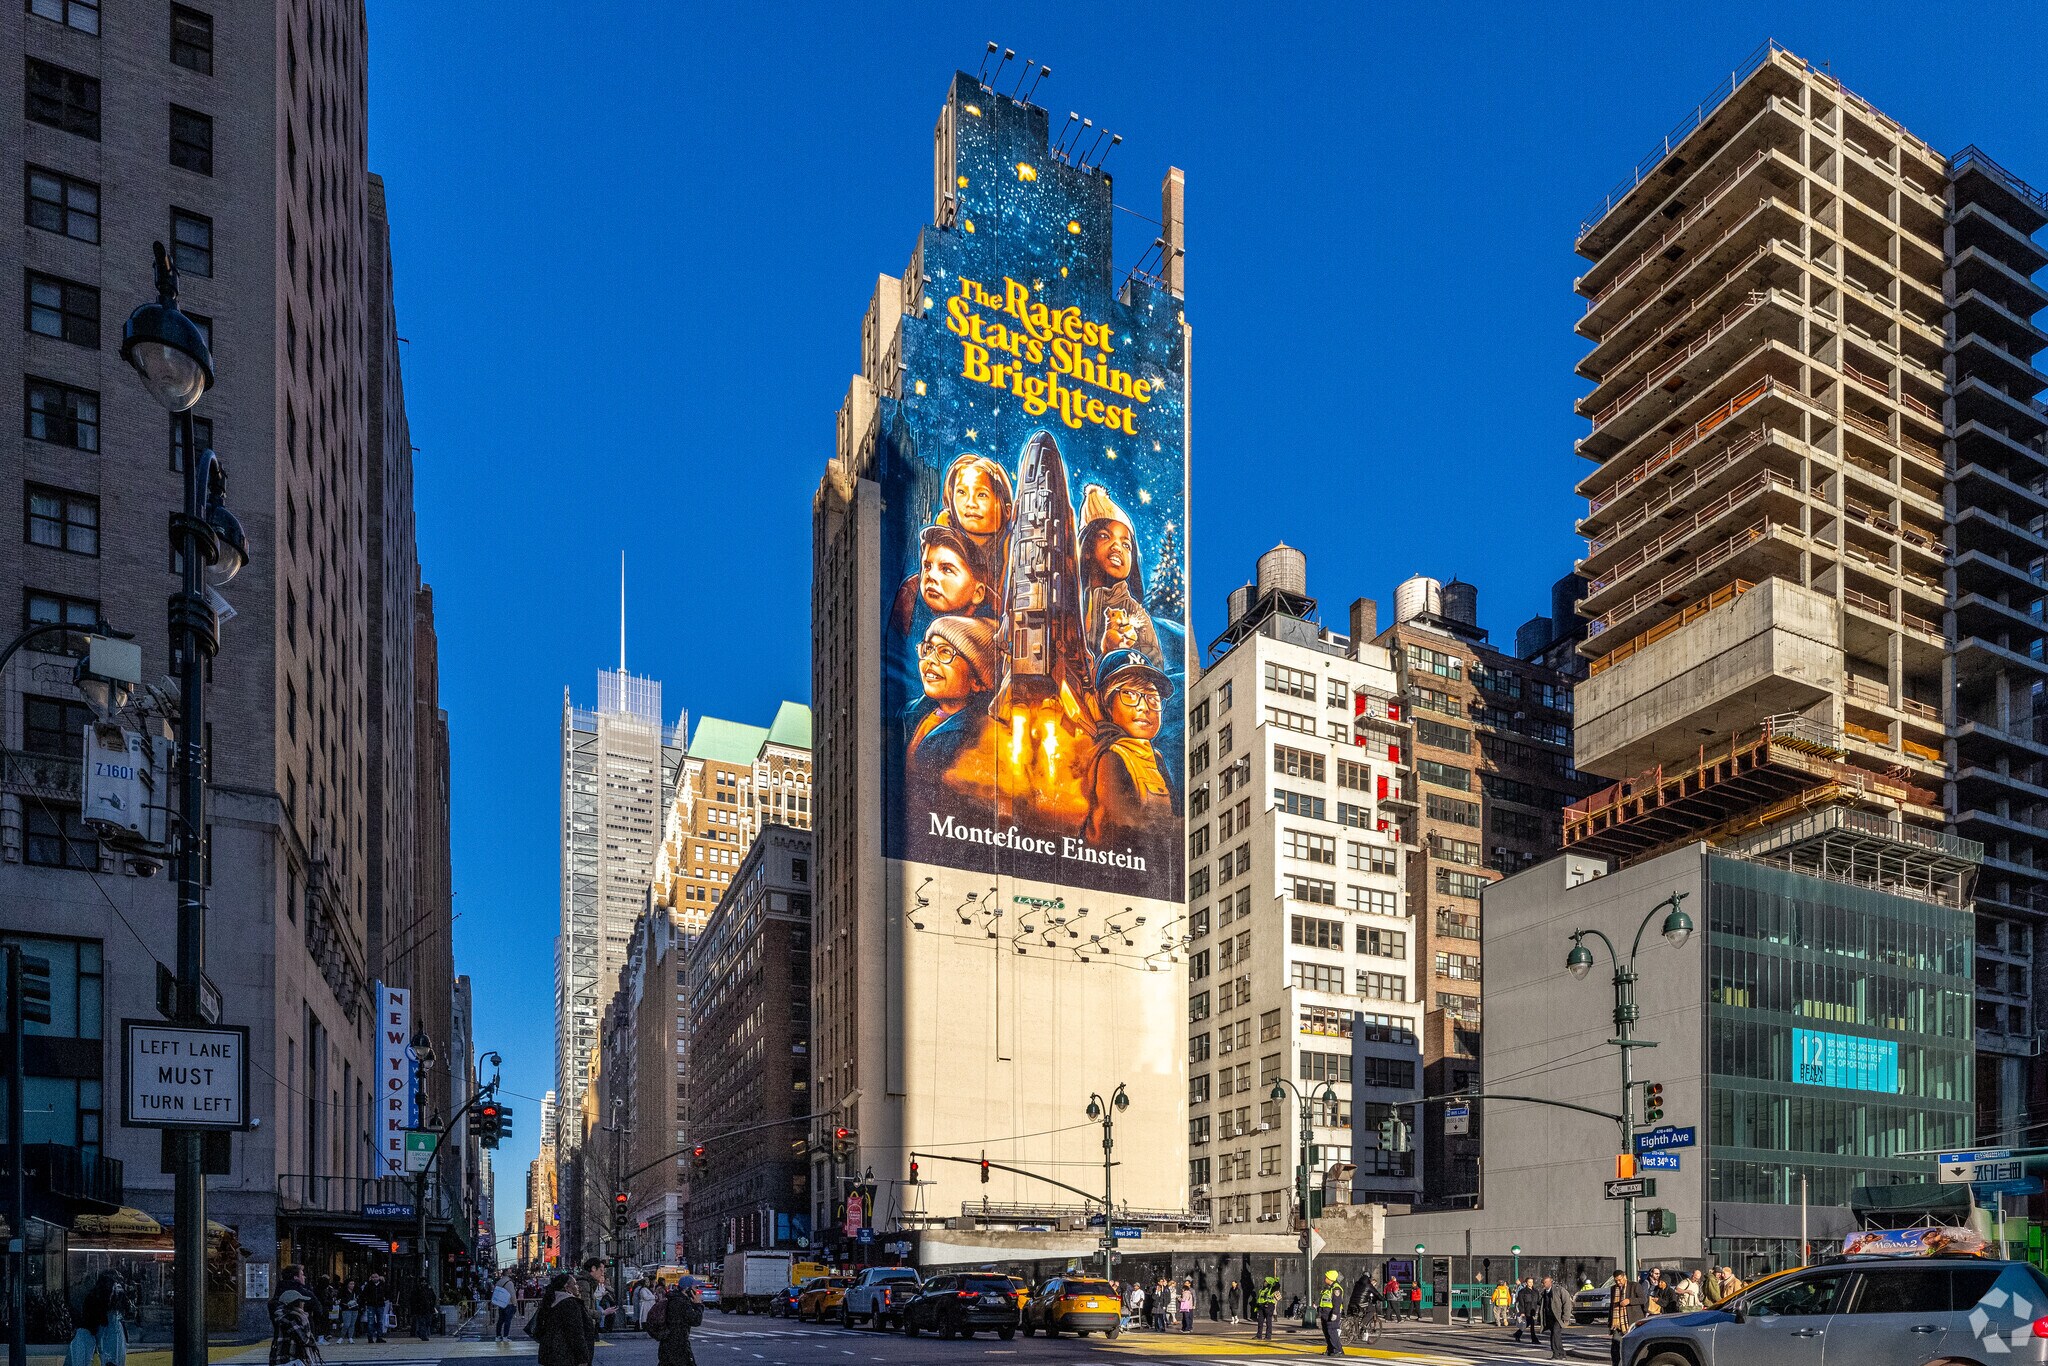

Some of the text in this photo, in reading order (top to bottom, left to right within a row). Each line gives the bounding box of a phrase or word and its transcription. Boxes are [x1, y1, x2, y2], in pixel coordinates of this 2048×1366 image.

[958, 275, 1115, 353] The Rarest
[946, 296, 1151, 403] Stars Shine
[961, 341, 1138, 436] Brightest
[95, 762, 134, 780] 7-1601
[928, 812, 1147, 871] Montefiore Einstein
[1017, 896, 1060, 908] LAMAR
[140, 1039, 231, 1058] LEFT LANE
[1800, 1035, 1823, 1066] 12
[1827, 1039, 1847, 1049] BRAND
[1848, 1042, 1877, 1053] YOURSELF
[158, 1066, 214, 1086] MUST
[1800, 1064, 1823, 1075] PENN
[1800, 1073, 1823, 1083] PLAZA
[387, 993, 405, 1172] NEW YORKER
[140, 1094, 232, 1111] TURN LEFT
[1641, 1133, 1689, 1148] Eighth Ave
[1657, 1156, 1668, 1166] 34th
[1669, 1157, 1677, 1167] St
[366, 1207, 410, 1215] West 34th St
[1873, 1240, 1909, 1249] MOANA
[1909, 1239, 1918, 1248] 2
